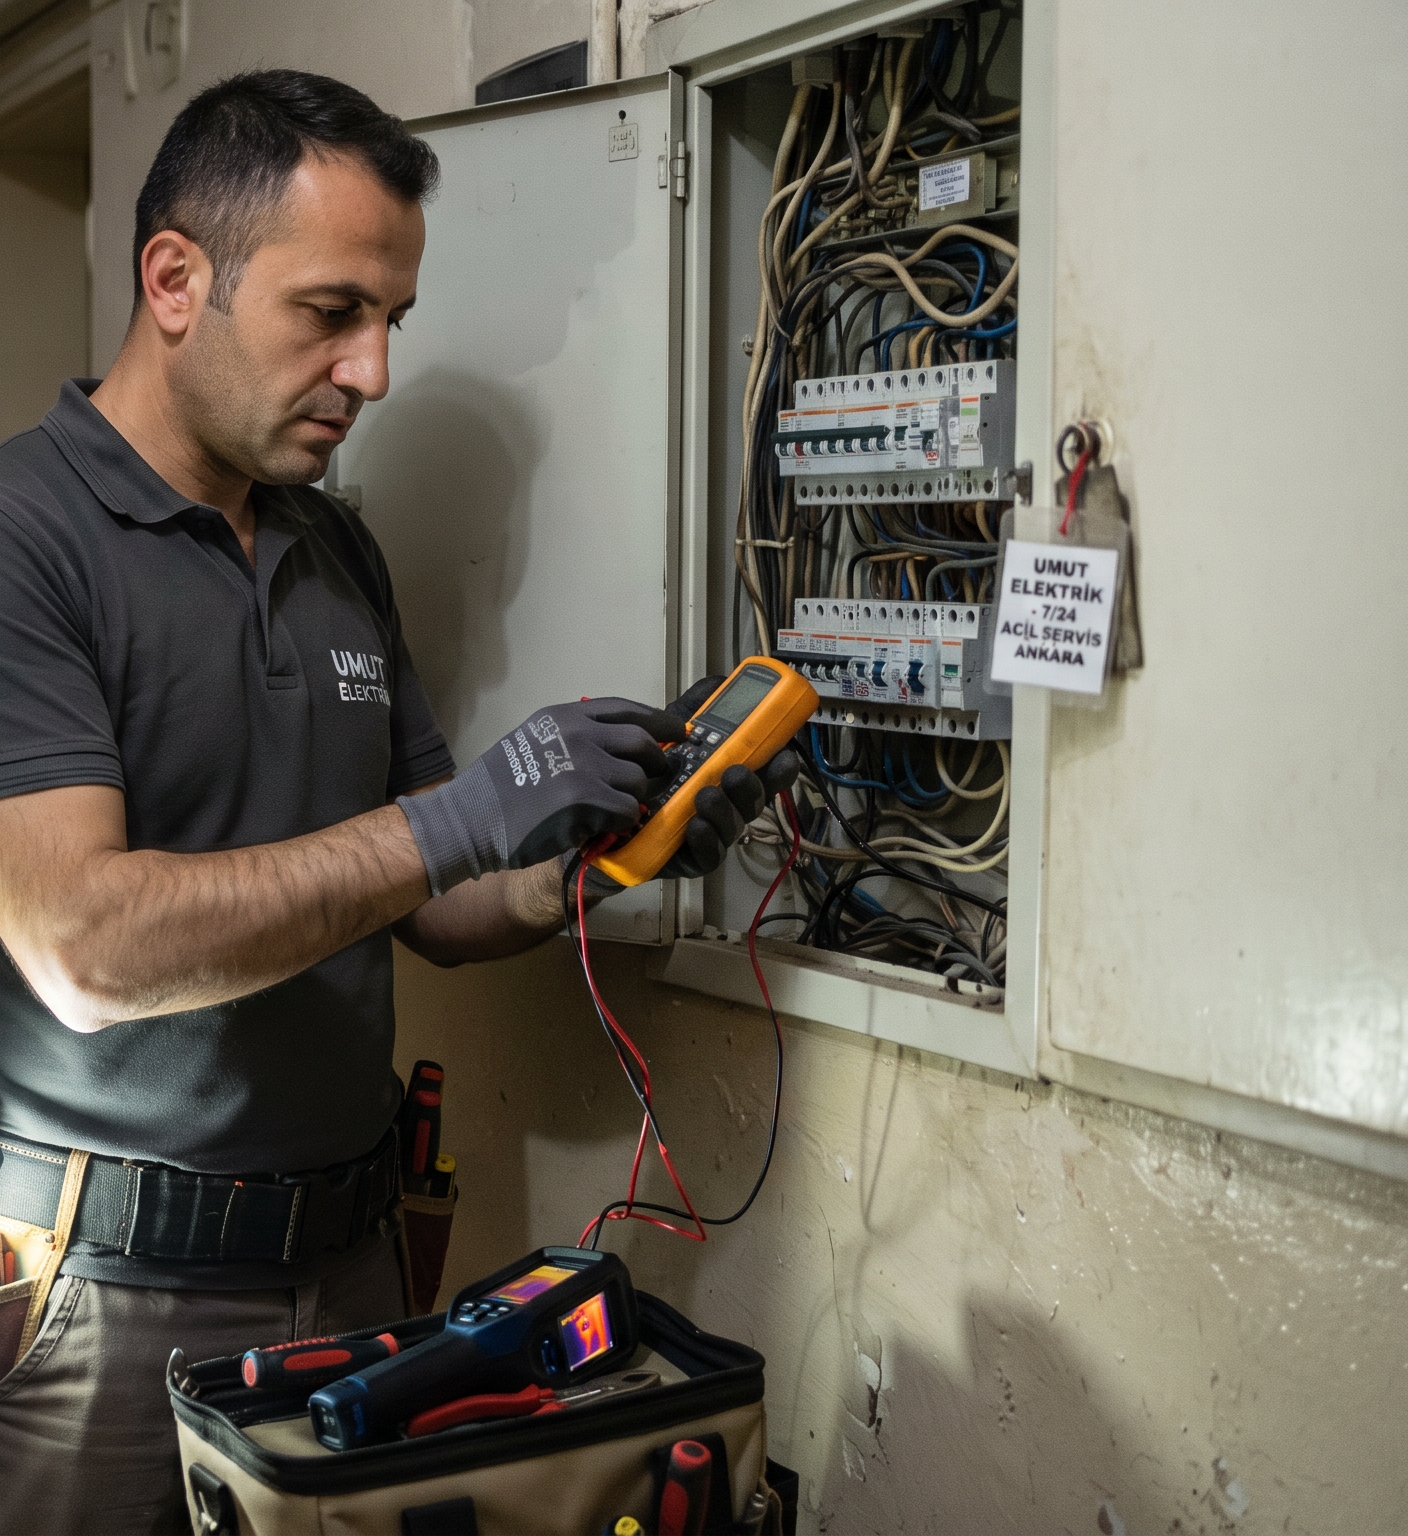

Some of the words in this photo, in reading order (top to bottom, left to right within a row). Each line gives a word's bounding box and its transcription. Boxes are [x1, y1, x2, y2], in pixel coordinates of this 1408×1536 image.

[1035, 558, 1088, 577] UMUT
[1011, 579, 1103, 603] ELEKTRİK
[1042, 604, 1077, 622] 7/24
[1015, 645, 1085, 665] ANKARA
[330, 649, 385, 682] UMUT
